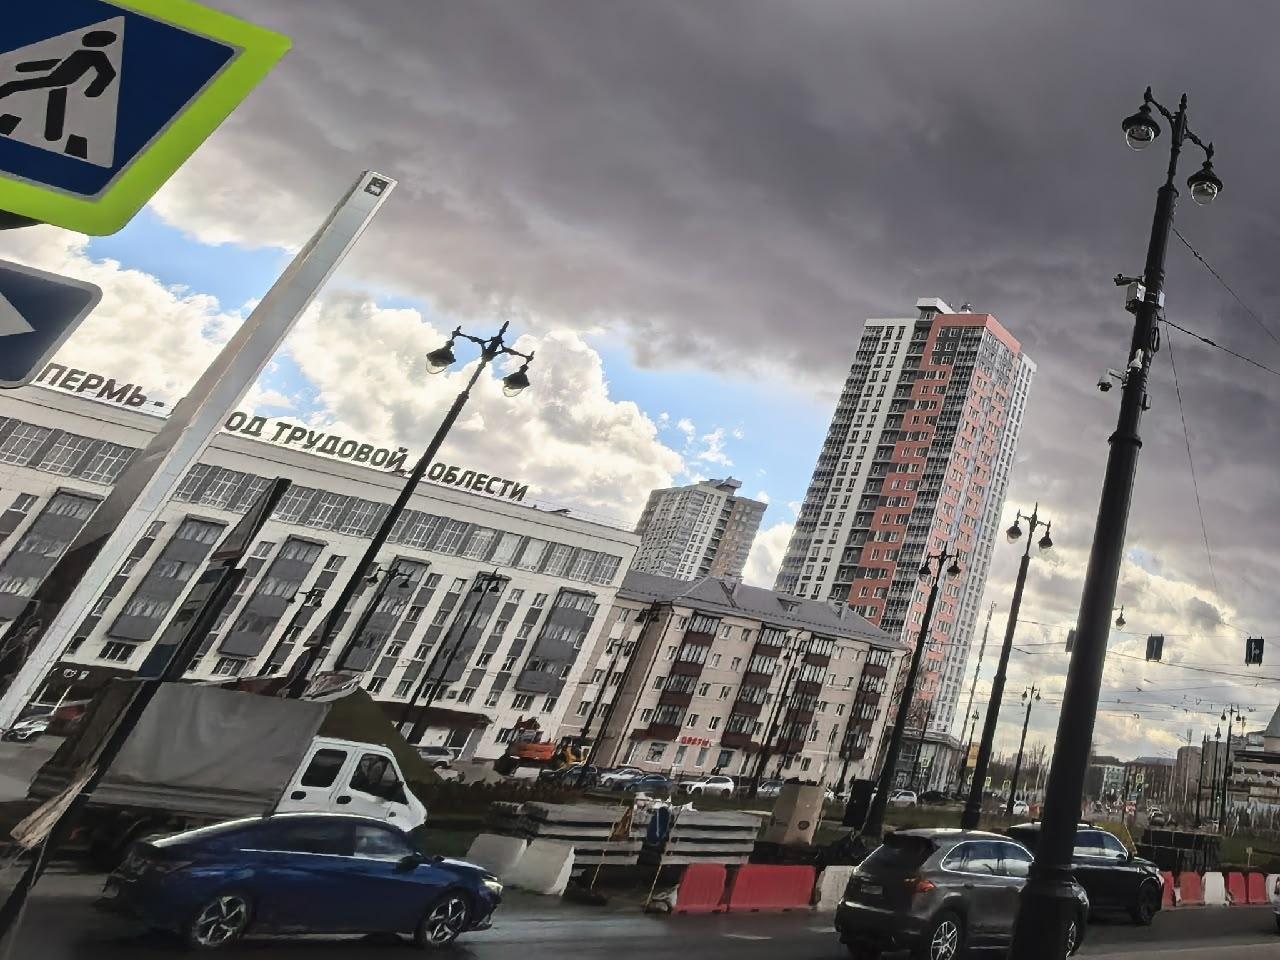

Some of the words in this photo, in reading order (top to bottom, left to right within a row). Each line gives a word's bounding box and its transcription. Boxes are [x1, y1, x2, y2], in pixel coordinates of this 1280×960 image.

[36, 363, 147, 407] ПЕРМЬ
[271, 421, 408, 471] ТРУДОВОЙ
[408, 460, 528, 502] ОБЛЕСТИ
